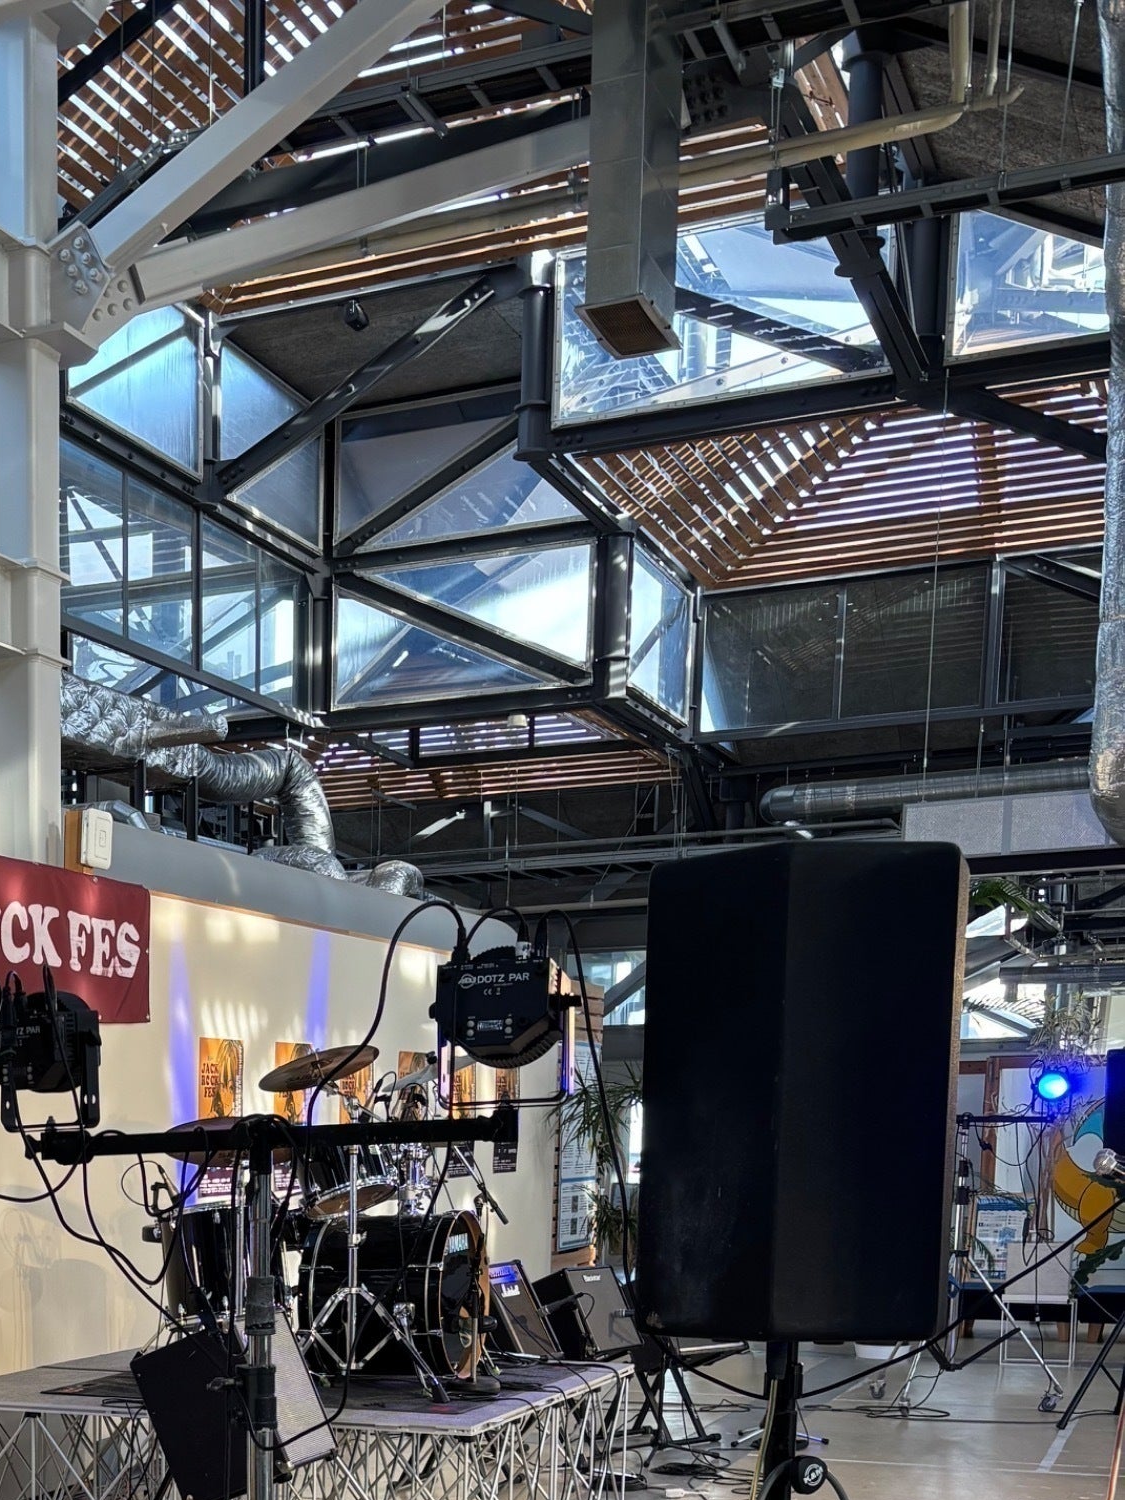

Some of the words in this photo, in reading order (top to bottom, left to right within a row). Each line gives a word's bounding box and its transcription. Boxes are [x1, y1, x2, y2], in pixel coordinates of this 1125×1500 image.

[67, 910, 141, 979] FES
[477, 974, 505, 984] DOTZ
[508, 972, 532, 982] PAR
